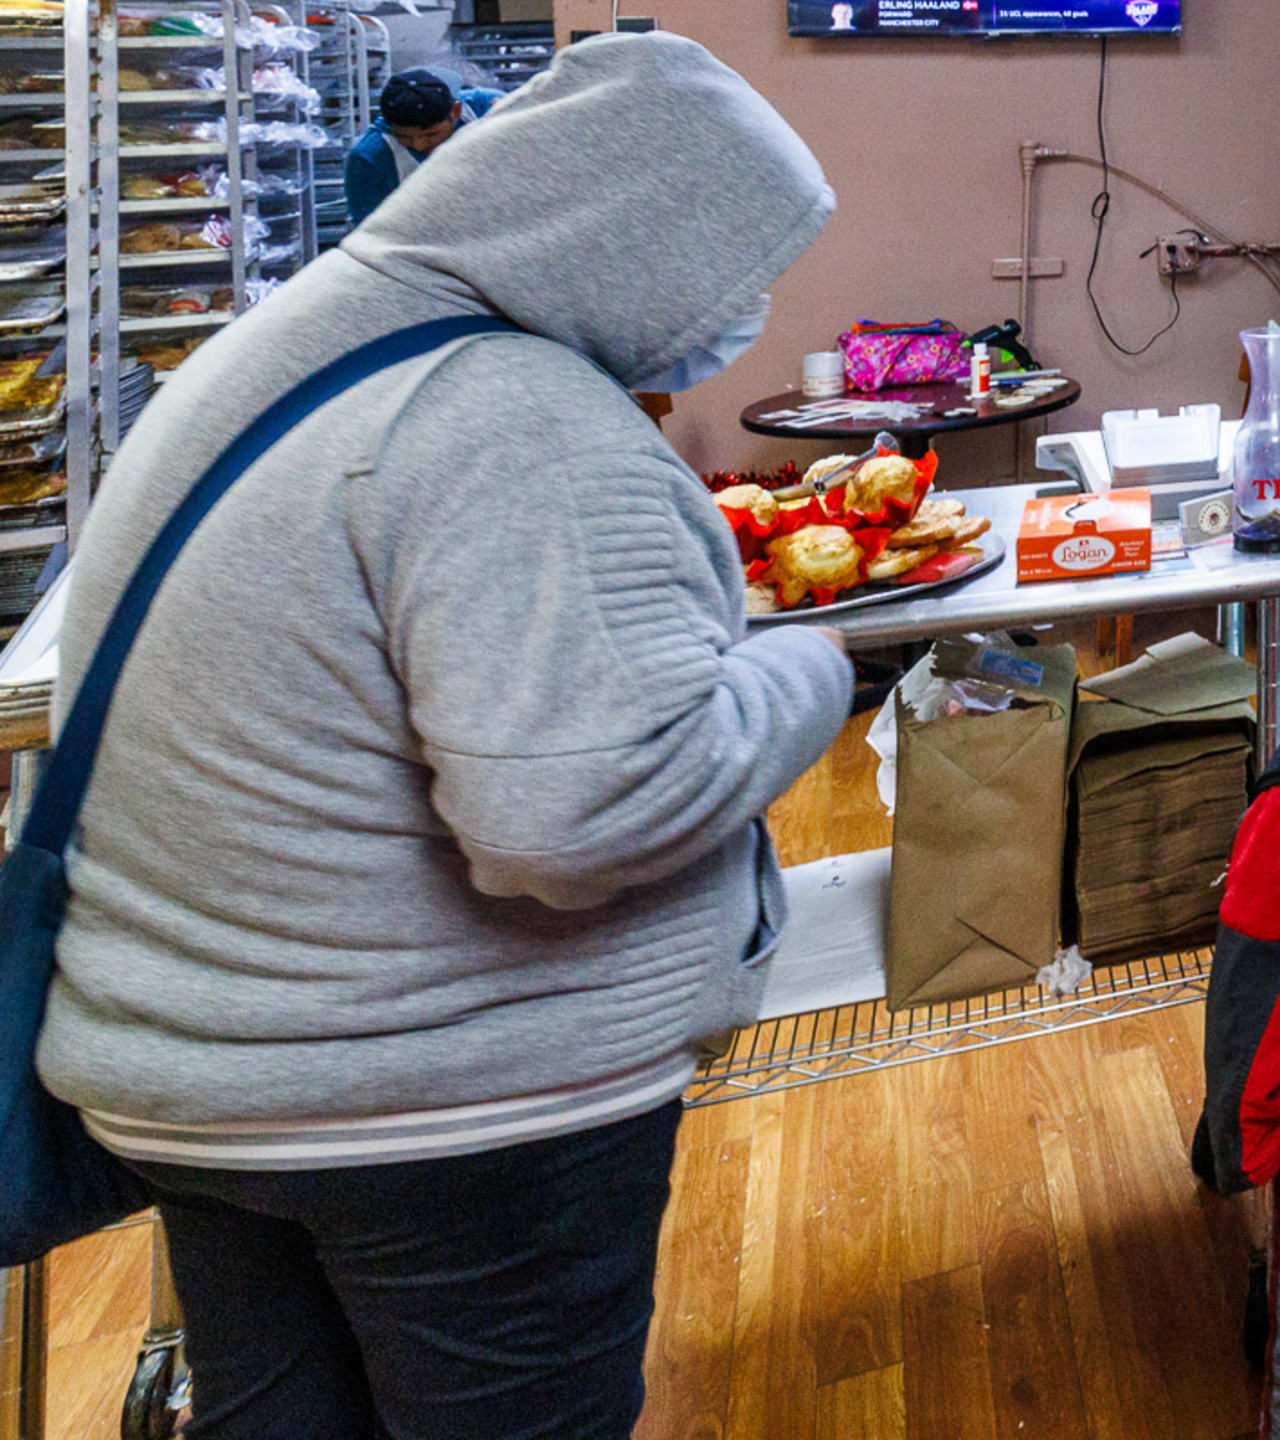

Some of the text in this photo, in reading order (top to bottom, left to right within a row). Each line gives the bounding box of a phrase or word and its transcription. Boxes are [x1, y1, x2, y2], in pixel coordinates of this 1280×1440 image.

[878, 0, 960, 10] ERLING HAALAND
[1061, 545, 1107, 562] Logan
